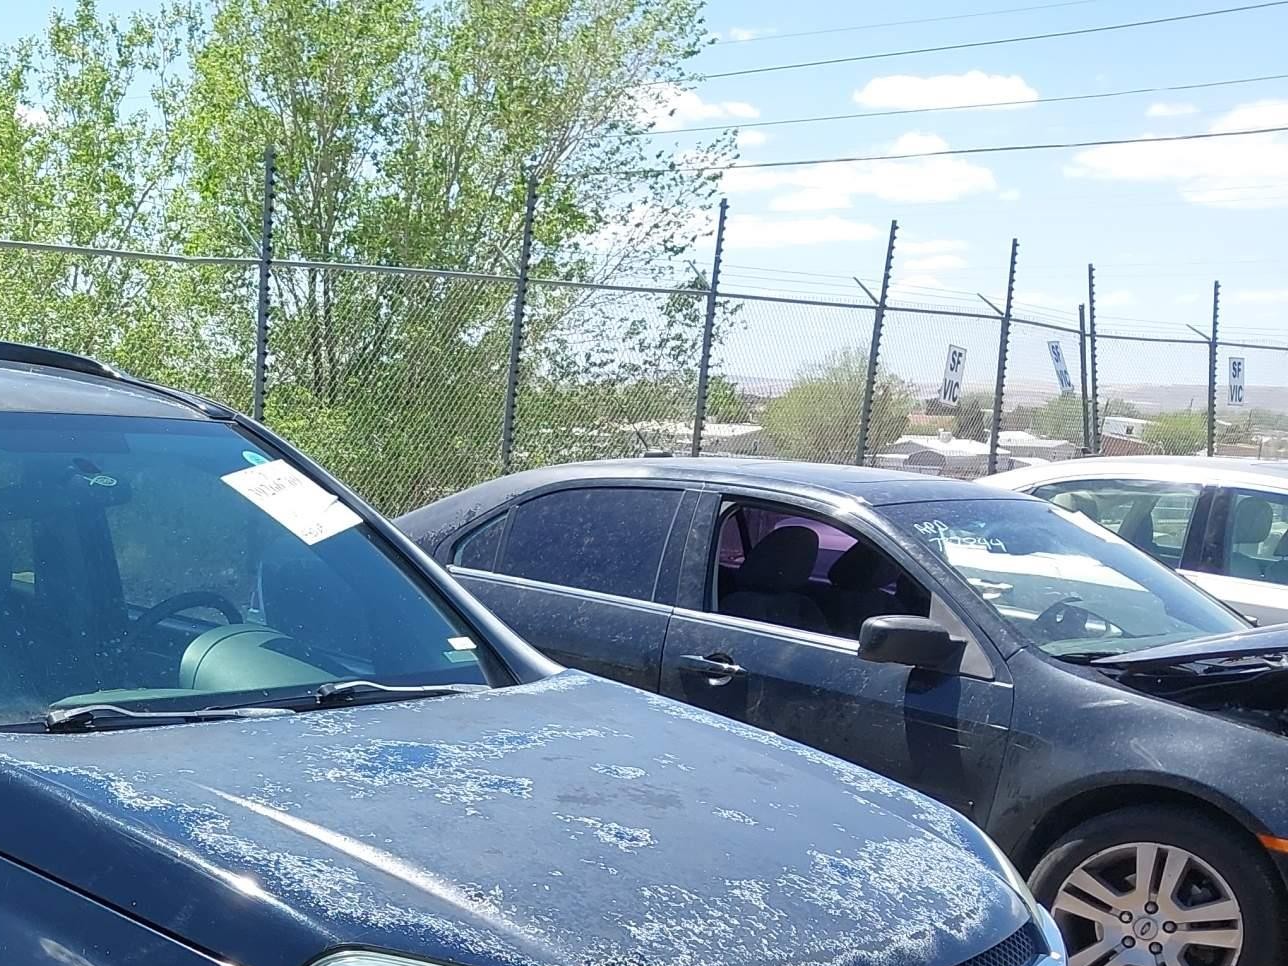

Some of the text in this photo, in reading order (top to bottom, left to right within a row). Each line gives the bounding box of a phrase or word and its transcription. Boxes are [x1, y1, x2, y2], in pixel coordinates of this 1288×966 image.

[950, 350, 963, 373] SF
[1051, 345, 1061, 363] SF
[1232, 361, 1242, 378] SF
[943, 378, 960, 403] VIC
[1230, 384, 1243, 402] VIC
